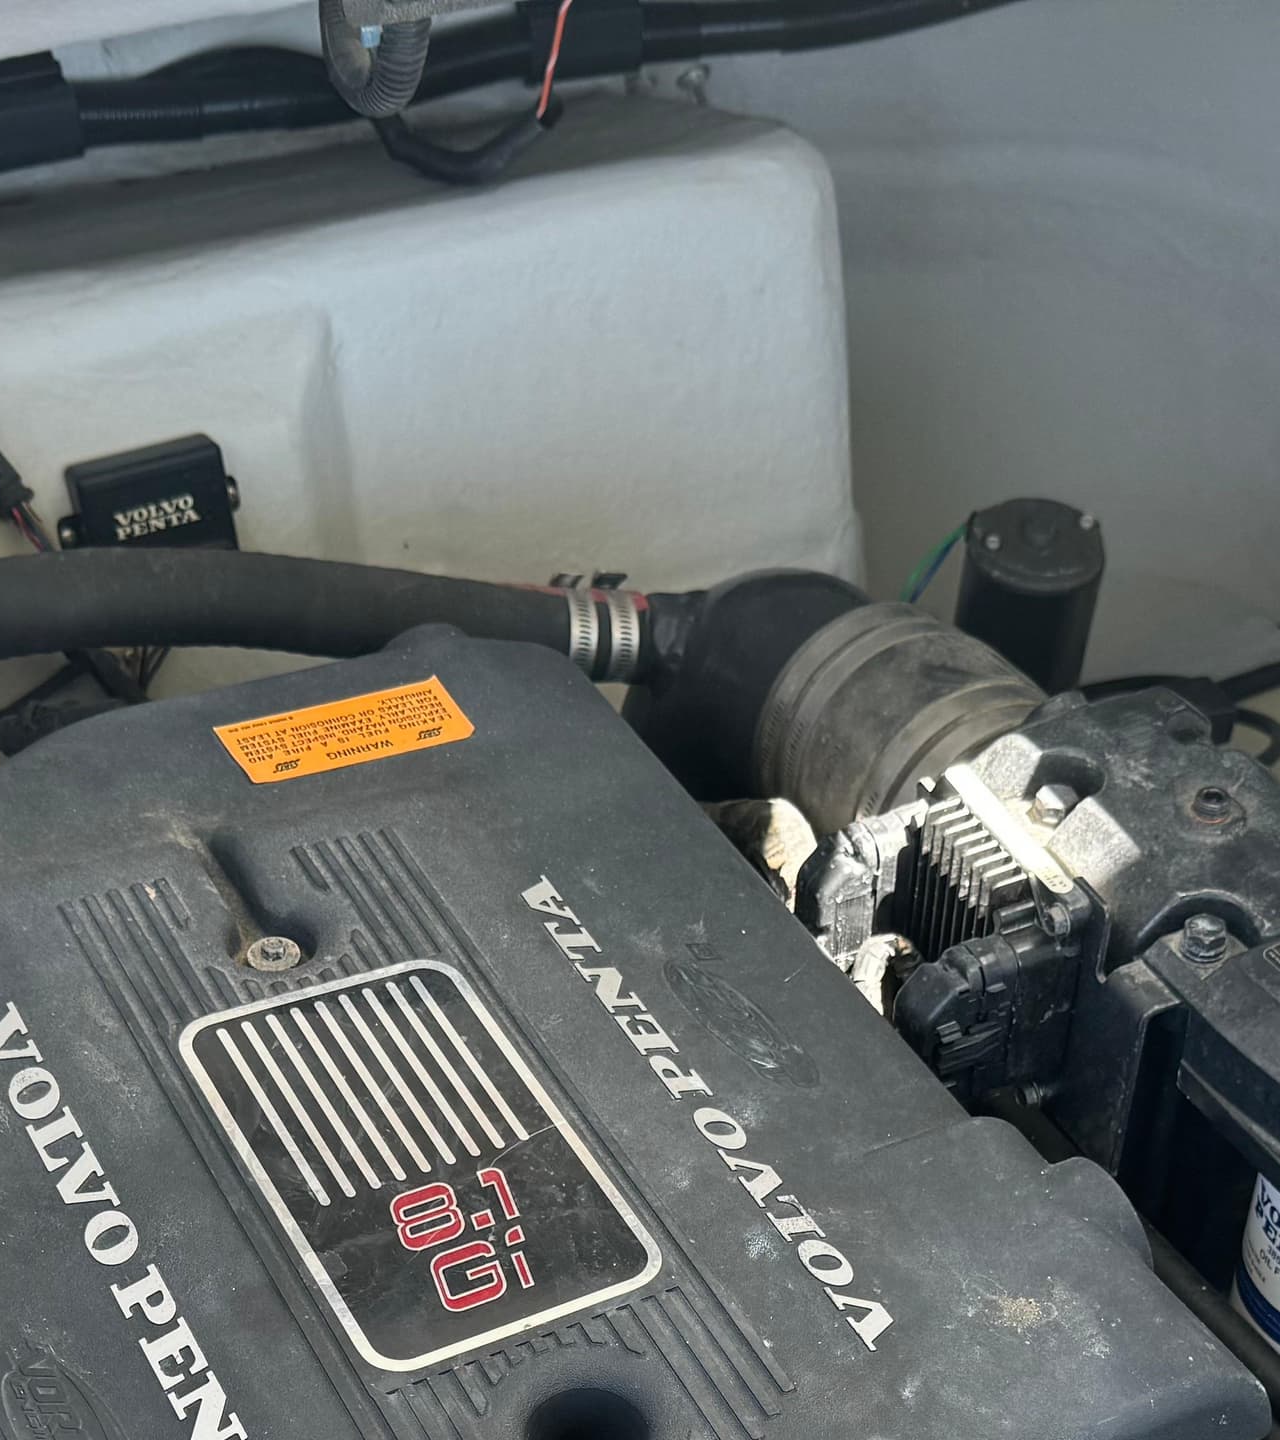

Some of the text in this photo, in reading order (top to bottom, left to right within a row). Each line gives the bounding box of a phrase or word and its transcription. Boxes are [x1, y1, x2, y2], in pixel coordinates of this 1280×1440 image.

[113, 493, 194, 524] VOLVO
[115, 509, 201, 540] PENTA
[376, 699, 413, 713] LEAKS
[414, 694, 438, 704] FOR
[290, 712, 355, 733] CORROSION
[321, 716, 372, 733] EXAMINE
[387, 706, 447, 726] EXPLOSION
[397, 712, 452, 730] LEAKING
[234, 731, 271, 745] LEAST
[288, 728, 318, 740] FUEL
[290, 731, 336, 747] INSPECT
[357, 727, 390, 739] FUEL
[238, 735, 285, 752] SYSTEM
[243, 742, 288, 758] SYSTEM
[282, 744, 311, 756] FIRE
[325, 737, 393, 760] WARNING
[247, 753, 275, 764] AND
[521, 875, 713, 1100] PENTA
[389, 1168, 521, 1251] 8.1
[693, 1107, 894, 1352] VOLVO
[1258, 1249, 1272, 1269] OIL
[430, 1225, 535, 1312] Gi
